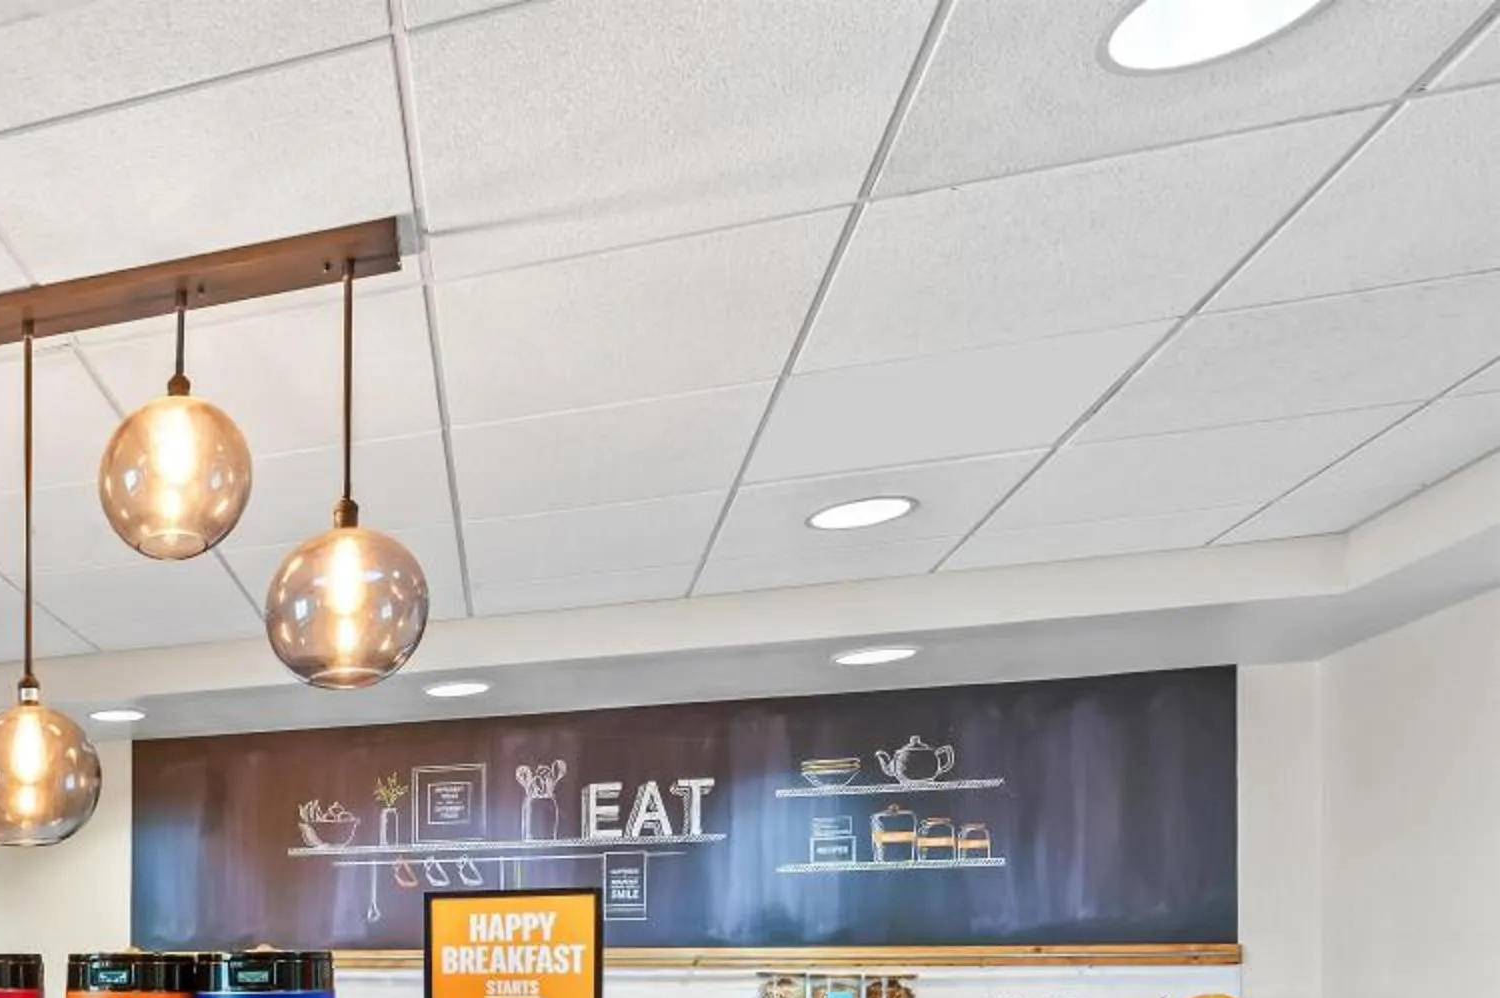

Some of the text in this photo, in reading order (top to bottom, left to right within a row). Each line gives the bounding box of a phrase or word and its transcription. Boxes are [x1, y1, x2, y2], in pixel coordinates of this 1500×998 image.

[582, 777, 715, 839] EAT
[468, 911, 557, 943] HAPPY
[441, 944, 587, 975] BREAKFAST
[485, 979, 540, 995] STARTS
